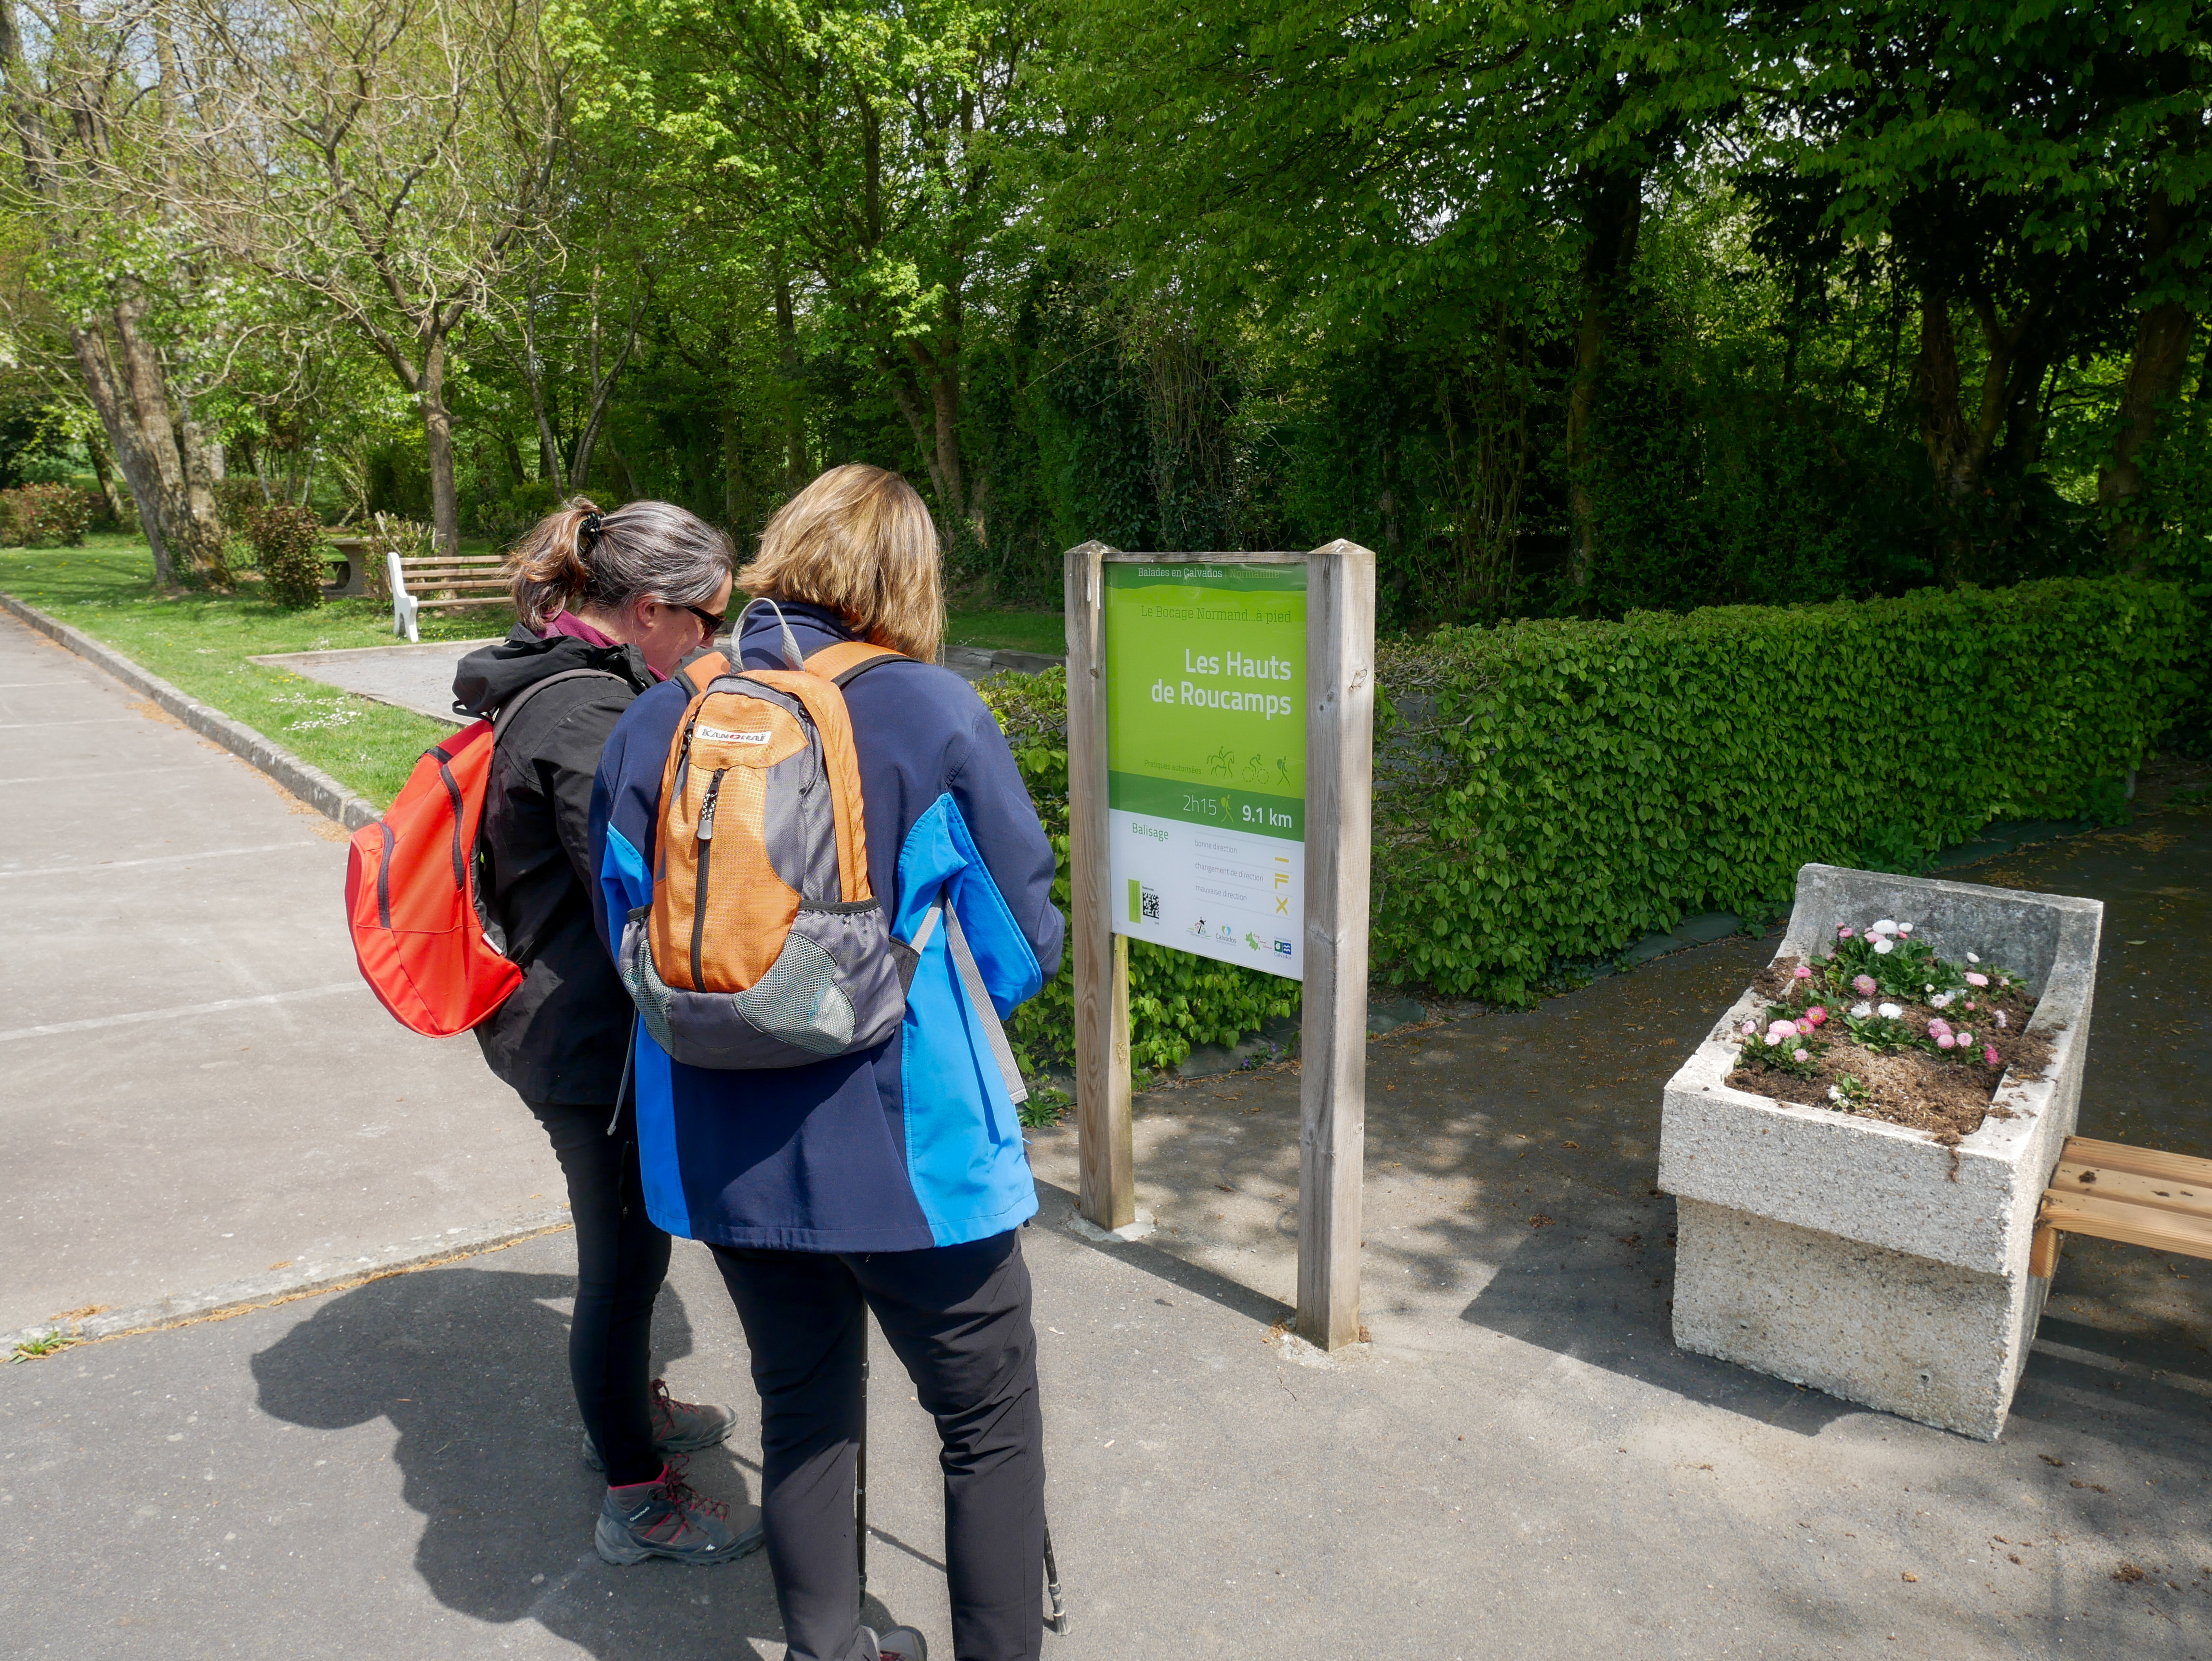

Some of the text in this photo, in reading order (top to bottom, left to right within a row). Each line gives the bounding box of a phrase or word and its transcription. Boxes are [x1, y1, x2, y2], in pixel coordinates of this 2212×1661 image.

[1138, 567, 1169, 577] Balades
[1184, 568, 1223, 578] Calvados
[1229, 568, 1279, 579] Normandie
[1141, 605, 1153, 617] Le
[1156, 606, 1194, 621] Bocage
[1265, 610, 1291, 624] pied
[1185, 648, 1292, 681] Les Hauts
[1151, 678, 1292, 720] de Roucamps
[1144, 759, 1202, 775] Pratiques autorisées
[1183, 794, 1292, 828] 2h15 9.1 km
[1132, 822, 1169, 842] Balisage
[1195, 839, 1238, 854] bonne direction
[1195, 862, 1229, 875] changement
[1238, 871, 1264, 882] direction
[1195, 885, 1247, 901] mauvaise direction
[1215, 933, 1237, 944] Calvados
